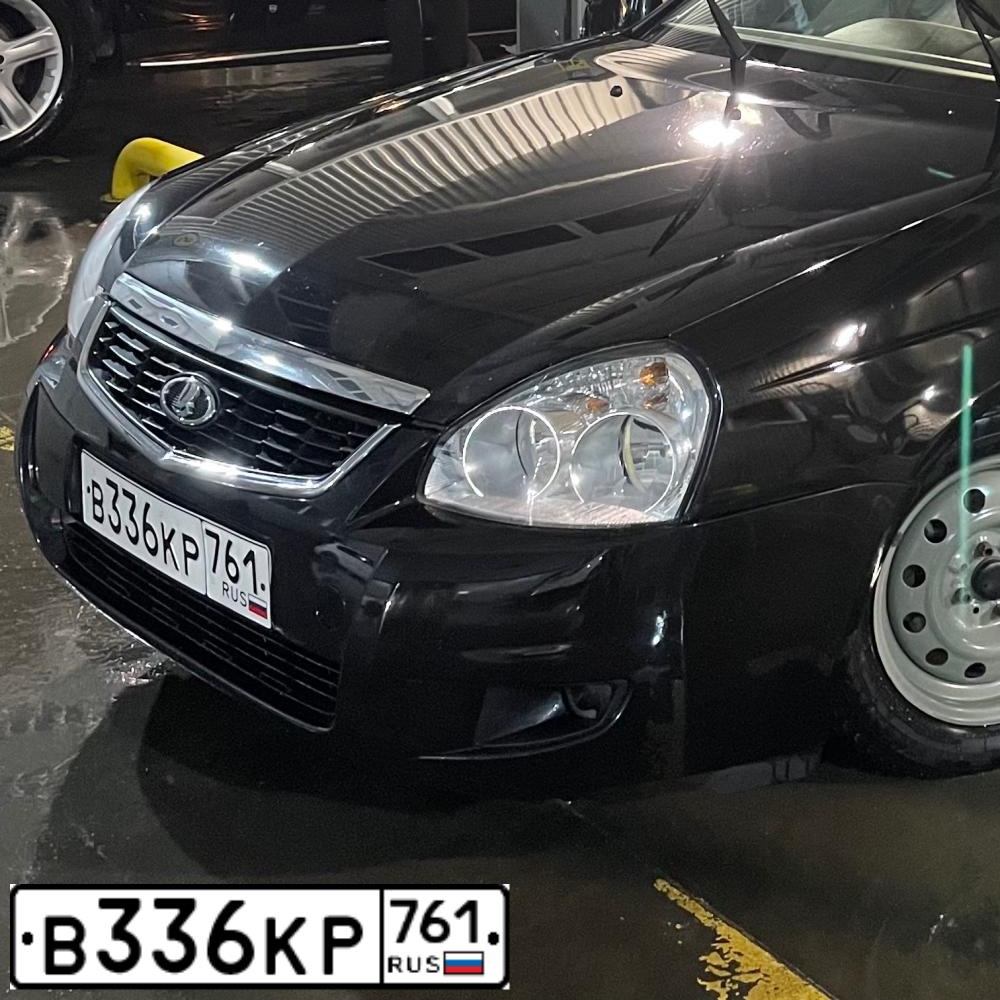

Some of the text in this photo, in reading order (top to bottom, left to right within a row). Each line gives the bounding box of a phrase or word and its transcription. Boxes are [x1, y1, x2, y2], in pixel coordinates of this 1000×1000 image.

[91, 477, 258, 595] В336КР 761
[222, 581, 247, 607] RUS
